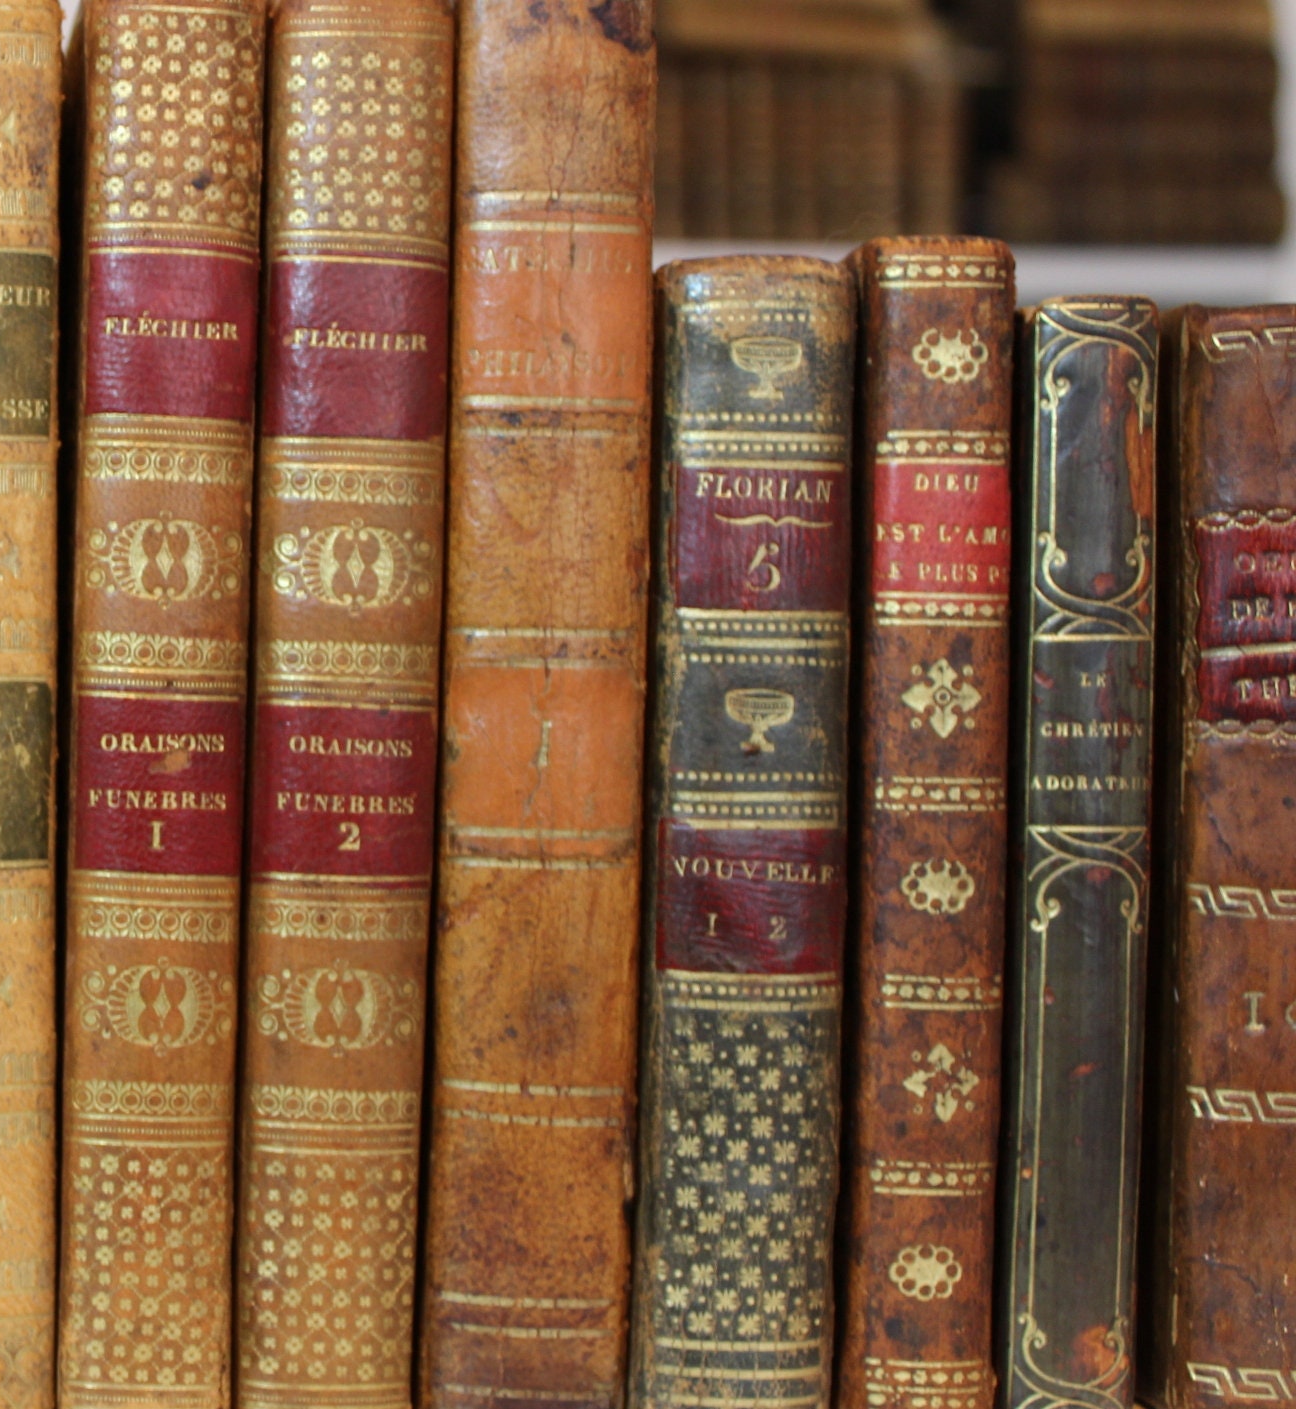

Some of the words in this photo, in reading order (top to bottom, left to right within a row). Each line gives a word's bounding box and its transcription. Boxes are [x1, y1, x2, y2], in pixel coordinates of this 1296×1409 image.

[104, 310, 239, 341] FLÉCHIER
[291, 322, 428, 351] FLÉCHIER
[695, 471, 834, 504] FLORIAN
[914, 472, 980, 495] DIEU
[939, 523, 1010, 546] L'AM
[745, 541, 782, 592] 5
[917, 562, 979, 583] PLUS
[1080, 671, 1107, 688] LE
[100, 732, 225, 753] ORAISONS
[288, 734, 413, 758] ORAISONS
[88, 788, 227, 811] FUNEBRES
[276, 790, 416, 815] FUNEBRES
[337, 820, 362, 852] 2
[767, 915, 788, 940] 2
